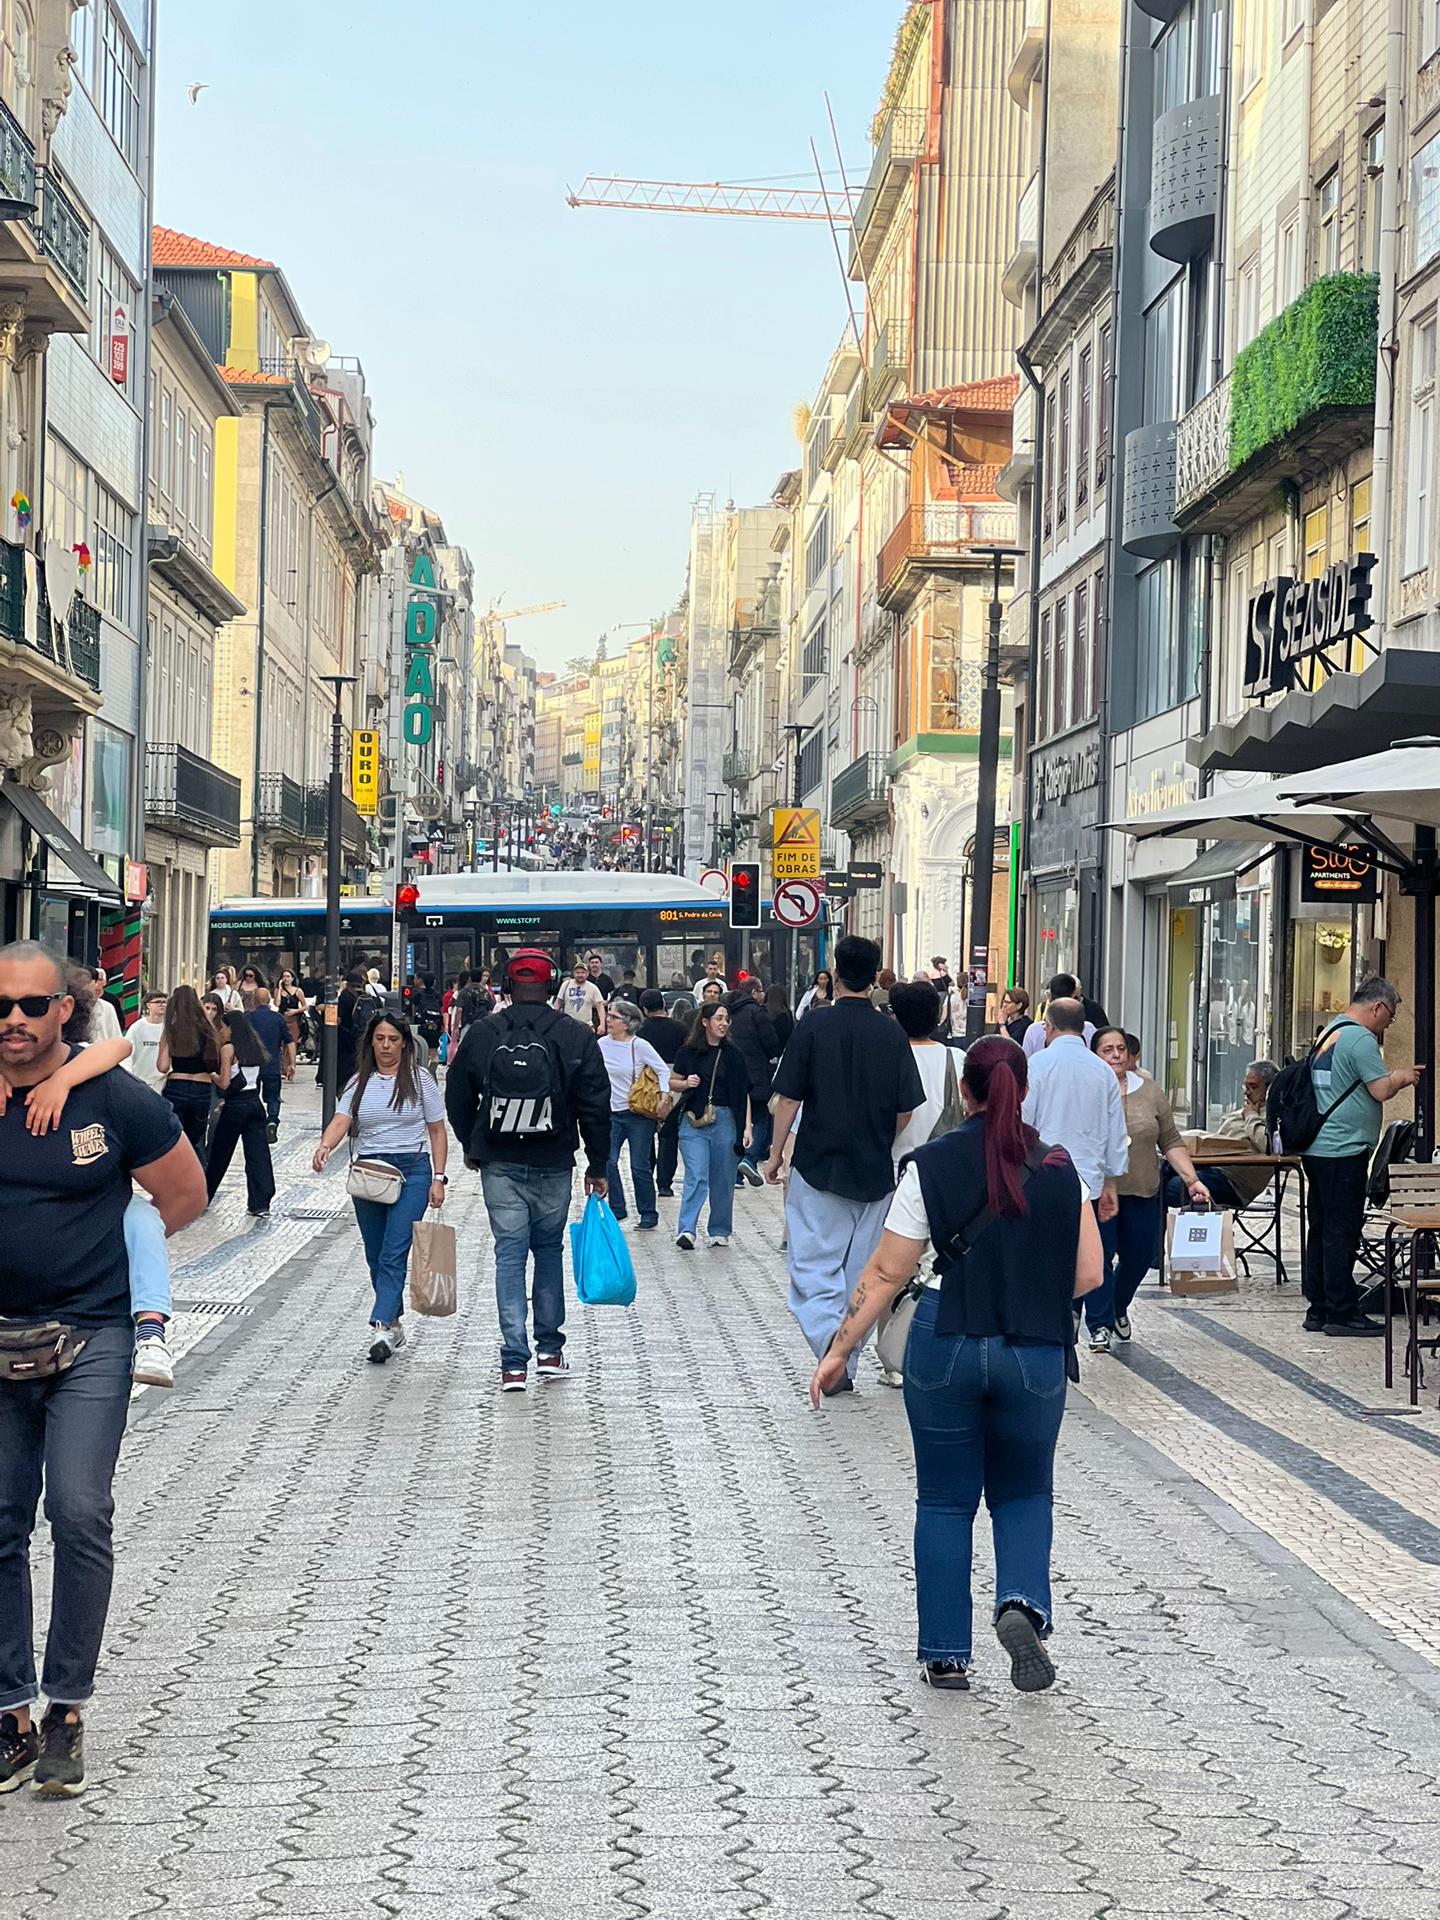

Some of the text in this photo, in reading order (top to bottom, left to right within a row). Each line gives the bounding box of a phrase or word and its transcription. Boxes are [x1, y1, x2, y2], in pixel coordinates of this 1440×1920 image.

[1279, 552, 1377, 663] SEASIDE
[359, 732, 373, 784] OURO
[777, 852, 816, 862] FIM DE
[777, 863, 817, 874] OBRAS
[1310, 871, 1351, 879] APARTMENTS
[495, 917, 541, 925] WWW.STCP.PT
[660, 910, 679, 921] 801
[489, 1096, 554, 1133] FILA
[73, 1126, 104, 1146] WHEELS
